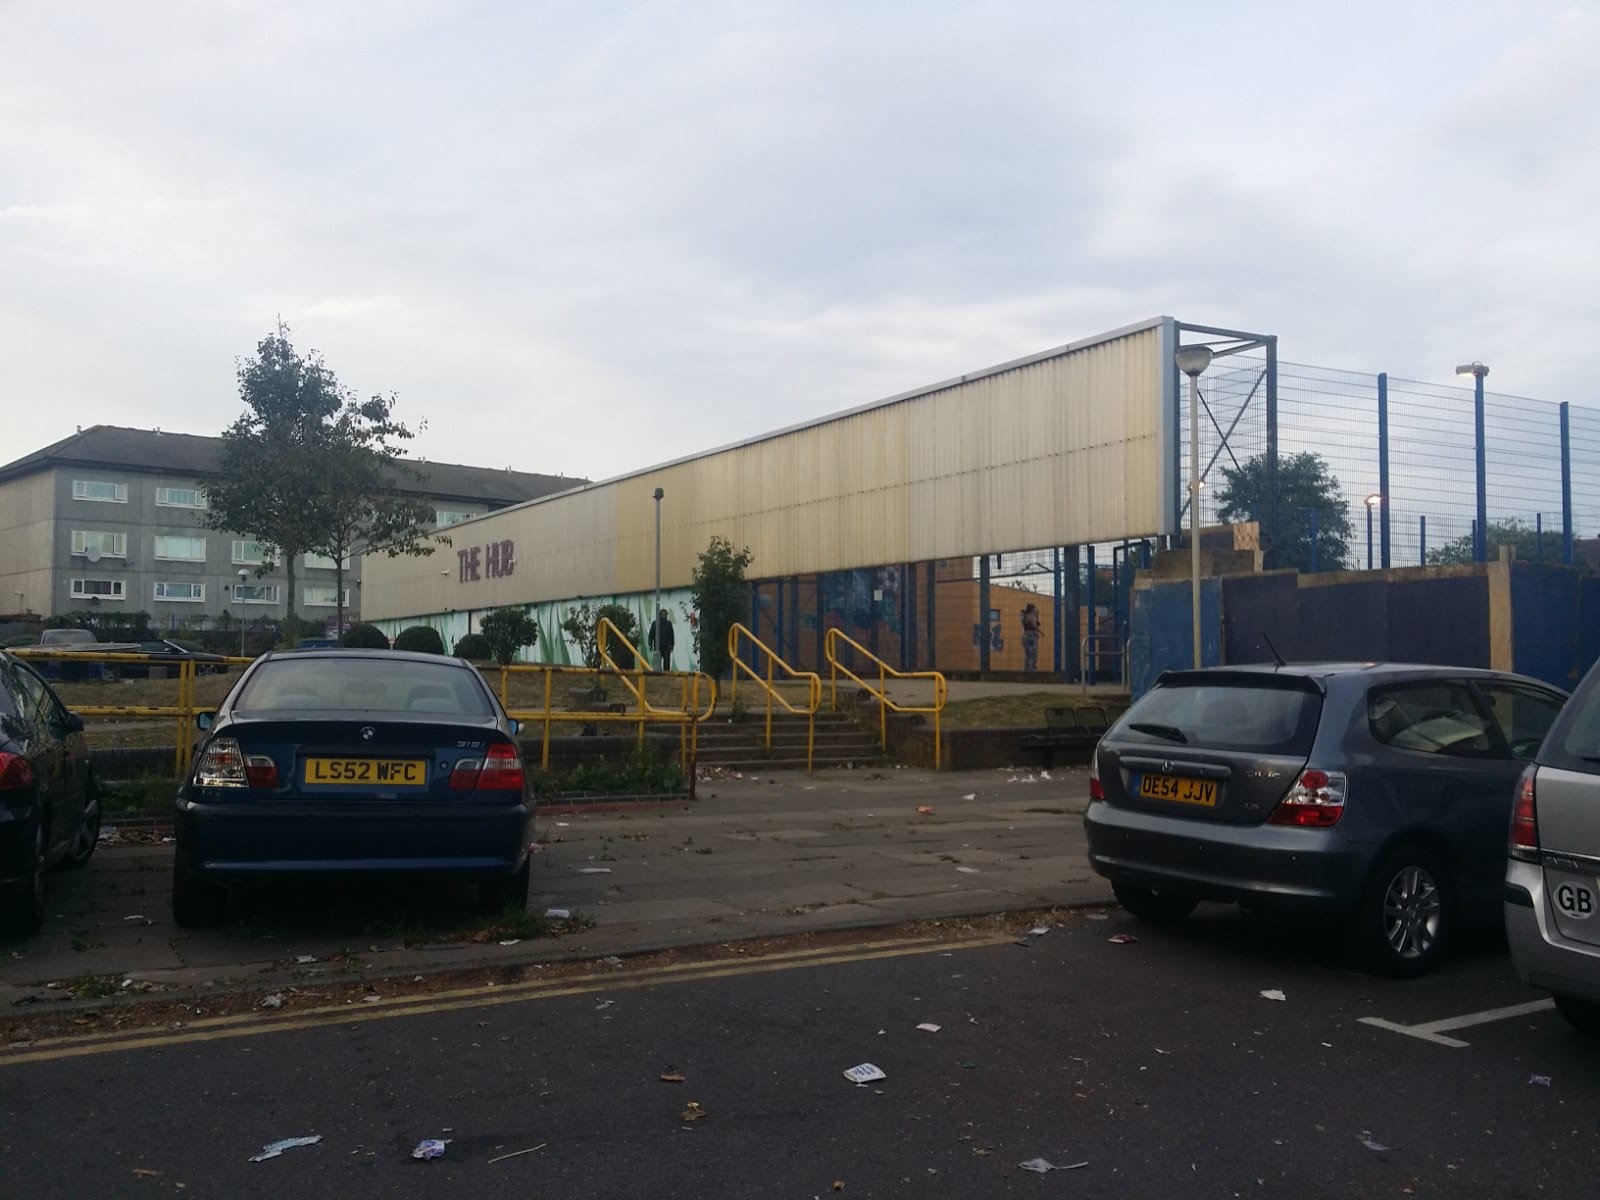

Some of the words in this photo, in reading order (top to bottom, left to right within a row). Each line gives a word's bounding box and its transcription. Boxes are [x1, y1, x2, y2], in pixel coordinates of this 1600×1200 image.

[457, 546, 481, 583] THE
[486, 539, 514, 578] HUB
[315, 761, 370, 780] LS52
[377, 762, 416, 781] WFC
[1142, 775, 1179, 797] OE54
[1183, 781, 1214, 803] JJV
[1559, 885, 1592, 913] GB
